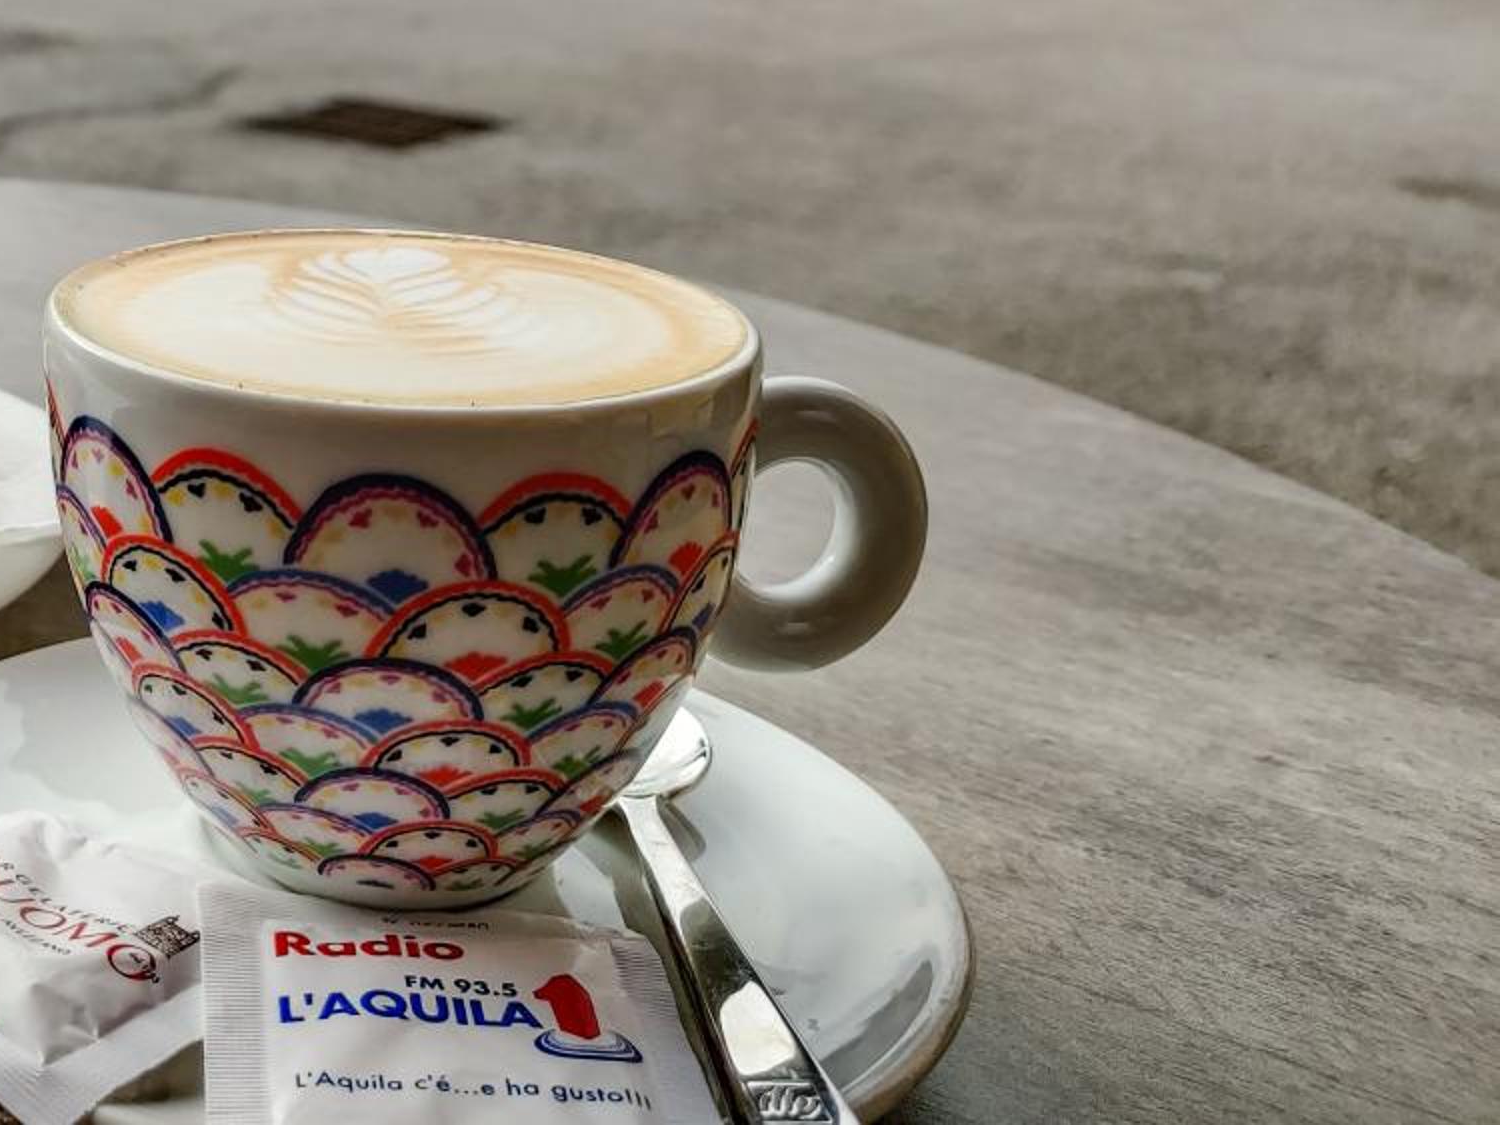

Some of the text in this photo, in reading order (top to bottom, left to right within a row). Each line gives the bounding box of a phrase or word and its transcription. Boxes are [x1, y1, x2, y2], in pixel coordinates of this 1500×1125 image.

[274, 930, 466, 961] Radio
[404, 974, 518, 998] FM 93.5
[277, 987, 544, 1030] L'AQUILA
[294, 1071, 403, 1094] L'Aquila
[505, 1078, 540, 1097] ha
